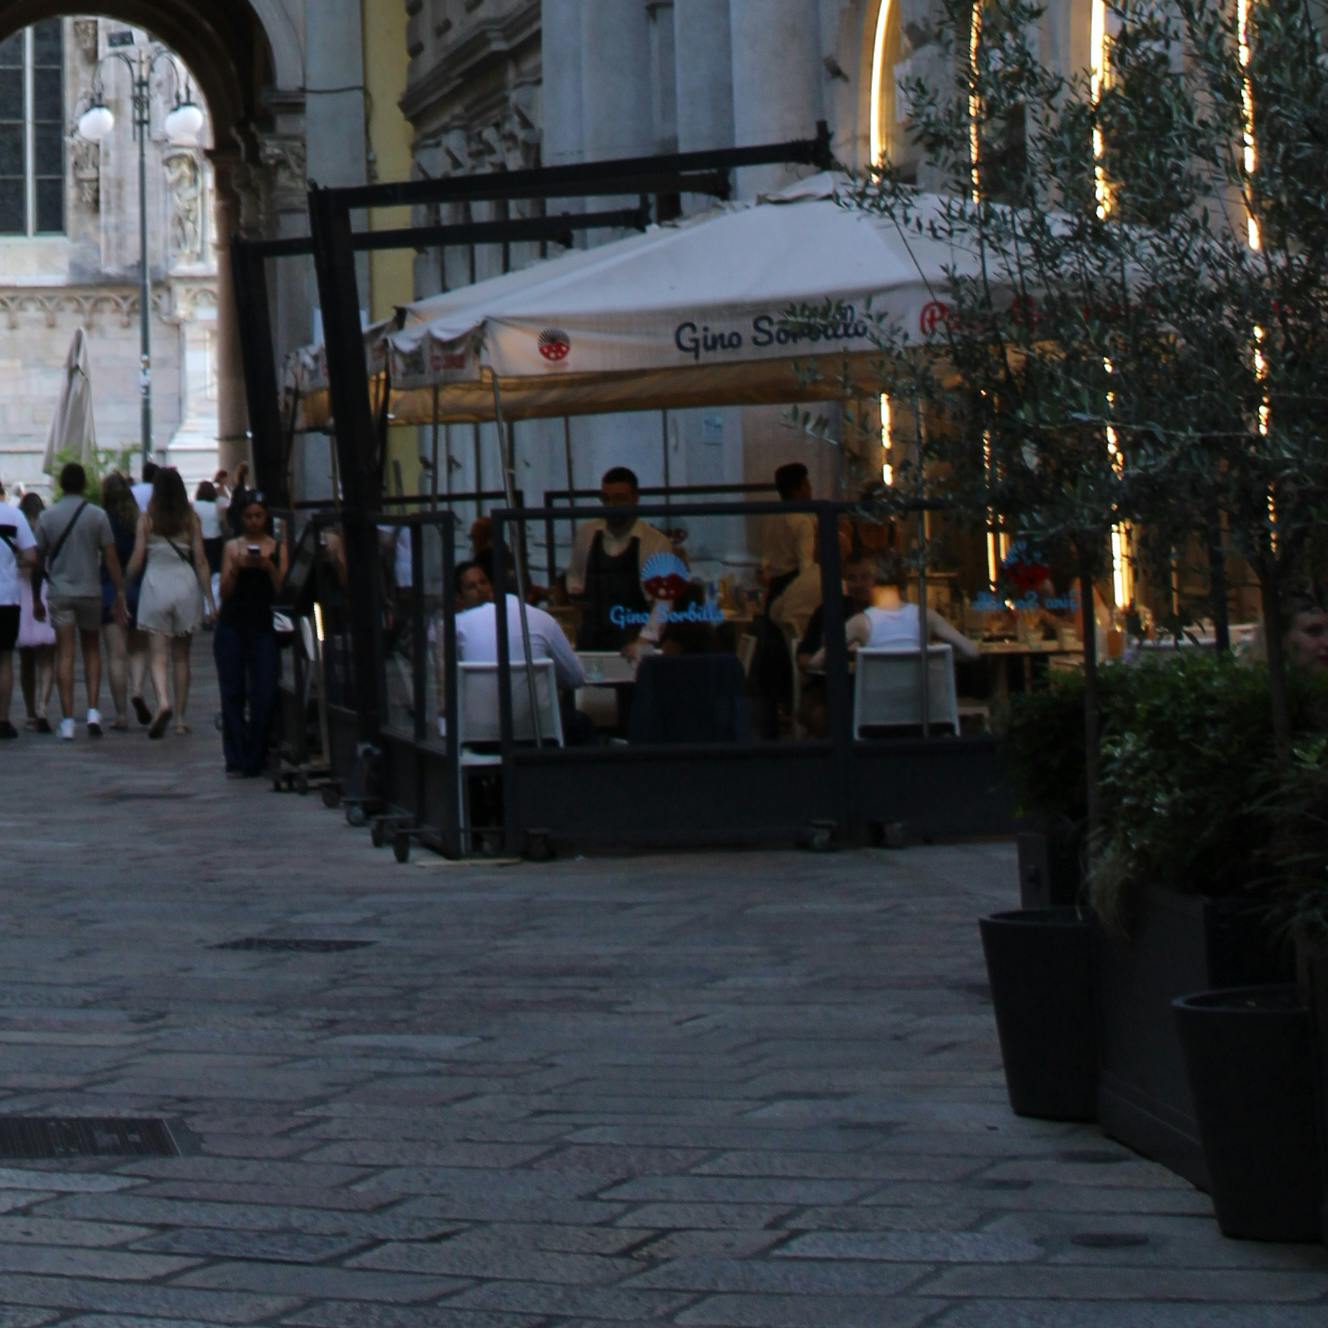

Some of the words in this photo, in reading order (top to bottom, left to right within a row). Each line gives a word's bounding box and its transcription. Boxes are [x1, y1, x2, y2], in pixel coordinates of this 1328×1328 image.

[674, 321, 743, 361] Gino
[610, 604, 650, 630] Gino
[654, 600, 725, 624] Sorbillo
